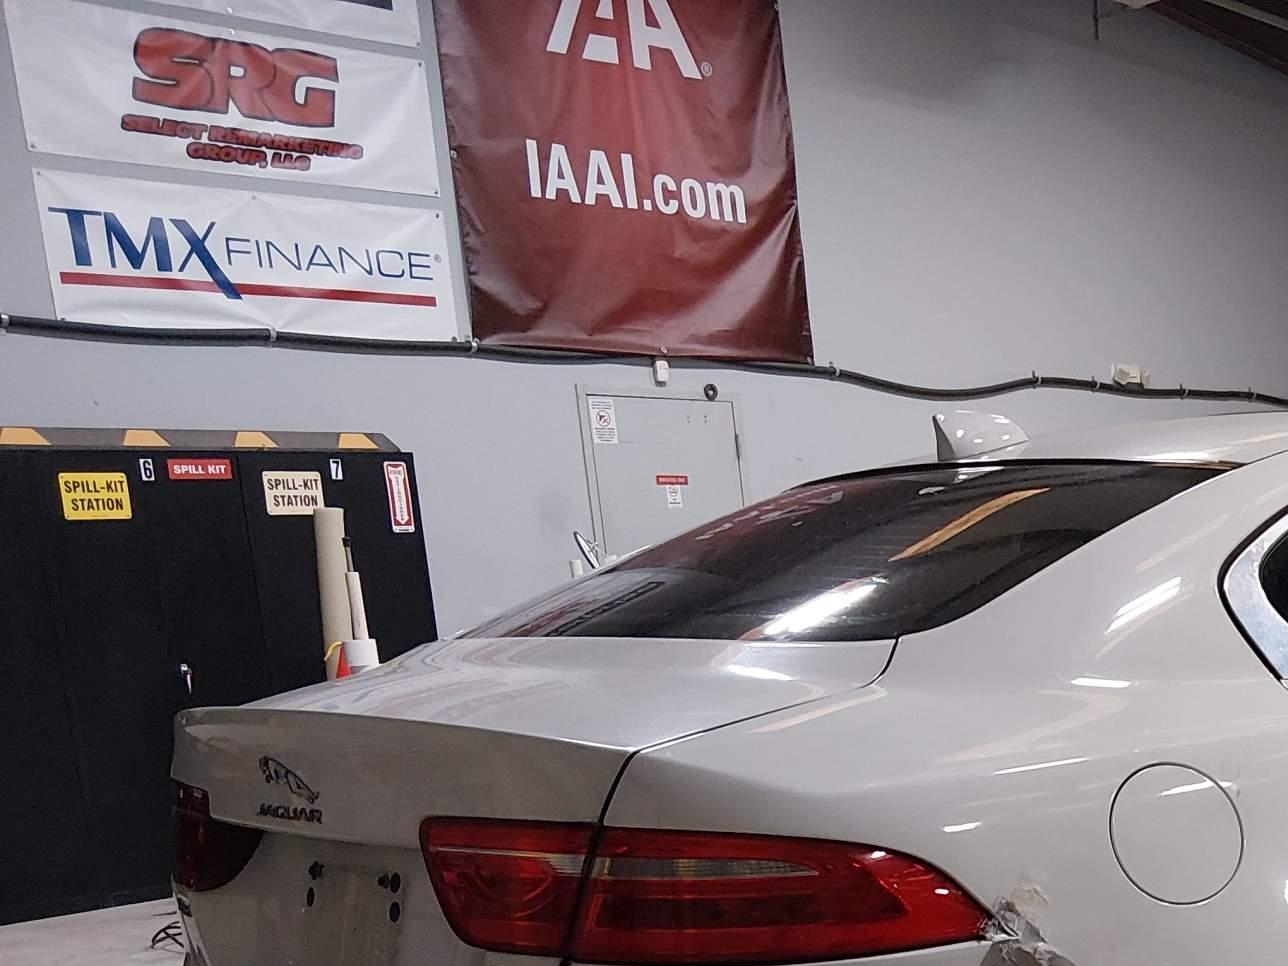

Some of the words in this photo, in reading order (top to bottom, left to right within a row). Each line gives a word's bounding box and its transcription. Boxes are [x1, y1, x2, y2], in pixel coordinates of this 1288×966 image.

[133, 27, 339, 128] SRG
[208, 124, 364, 160] REMARKETING
[270, 153, 311, 171] LLC
[525, 138, 747, 224] IAAI.com
[48, 206, 243, 300] TMX
[142, 460, 153, 479] 6
[173, 464, 206, 474] SPILL
[207, 464, 226, 474] KIT
[331, 460, 340, 479] 7
[63, 480, 125, 494] SPILL-KIT
[267, 478, 320, 491] SPILL-KIT
[71, 498, 124, 511] STATION
[273, 495, 318, 507] STATION
[257, 803, 323, 824] JAGUAR
